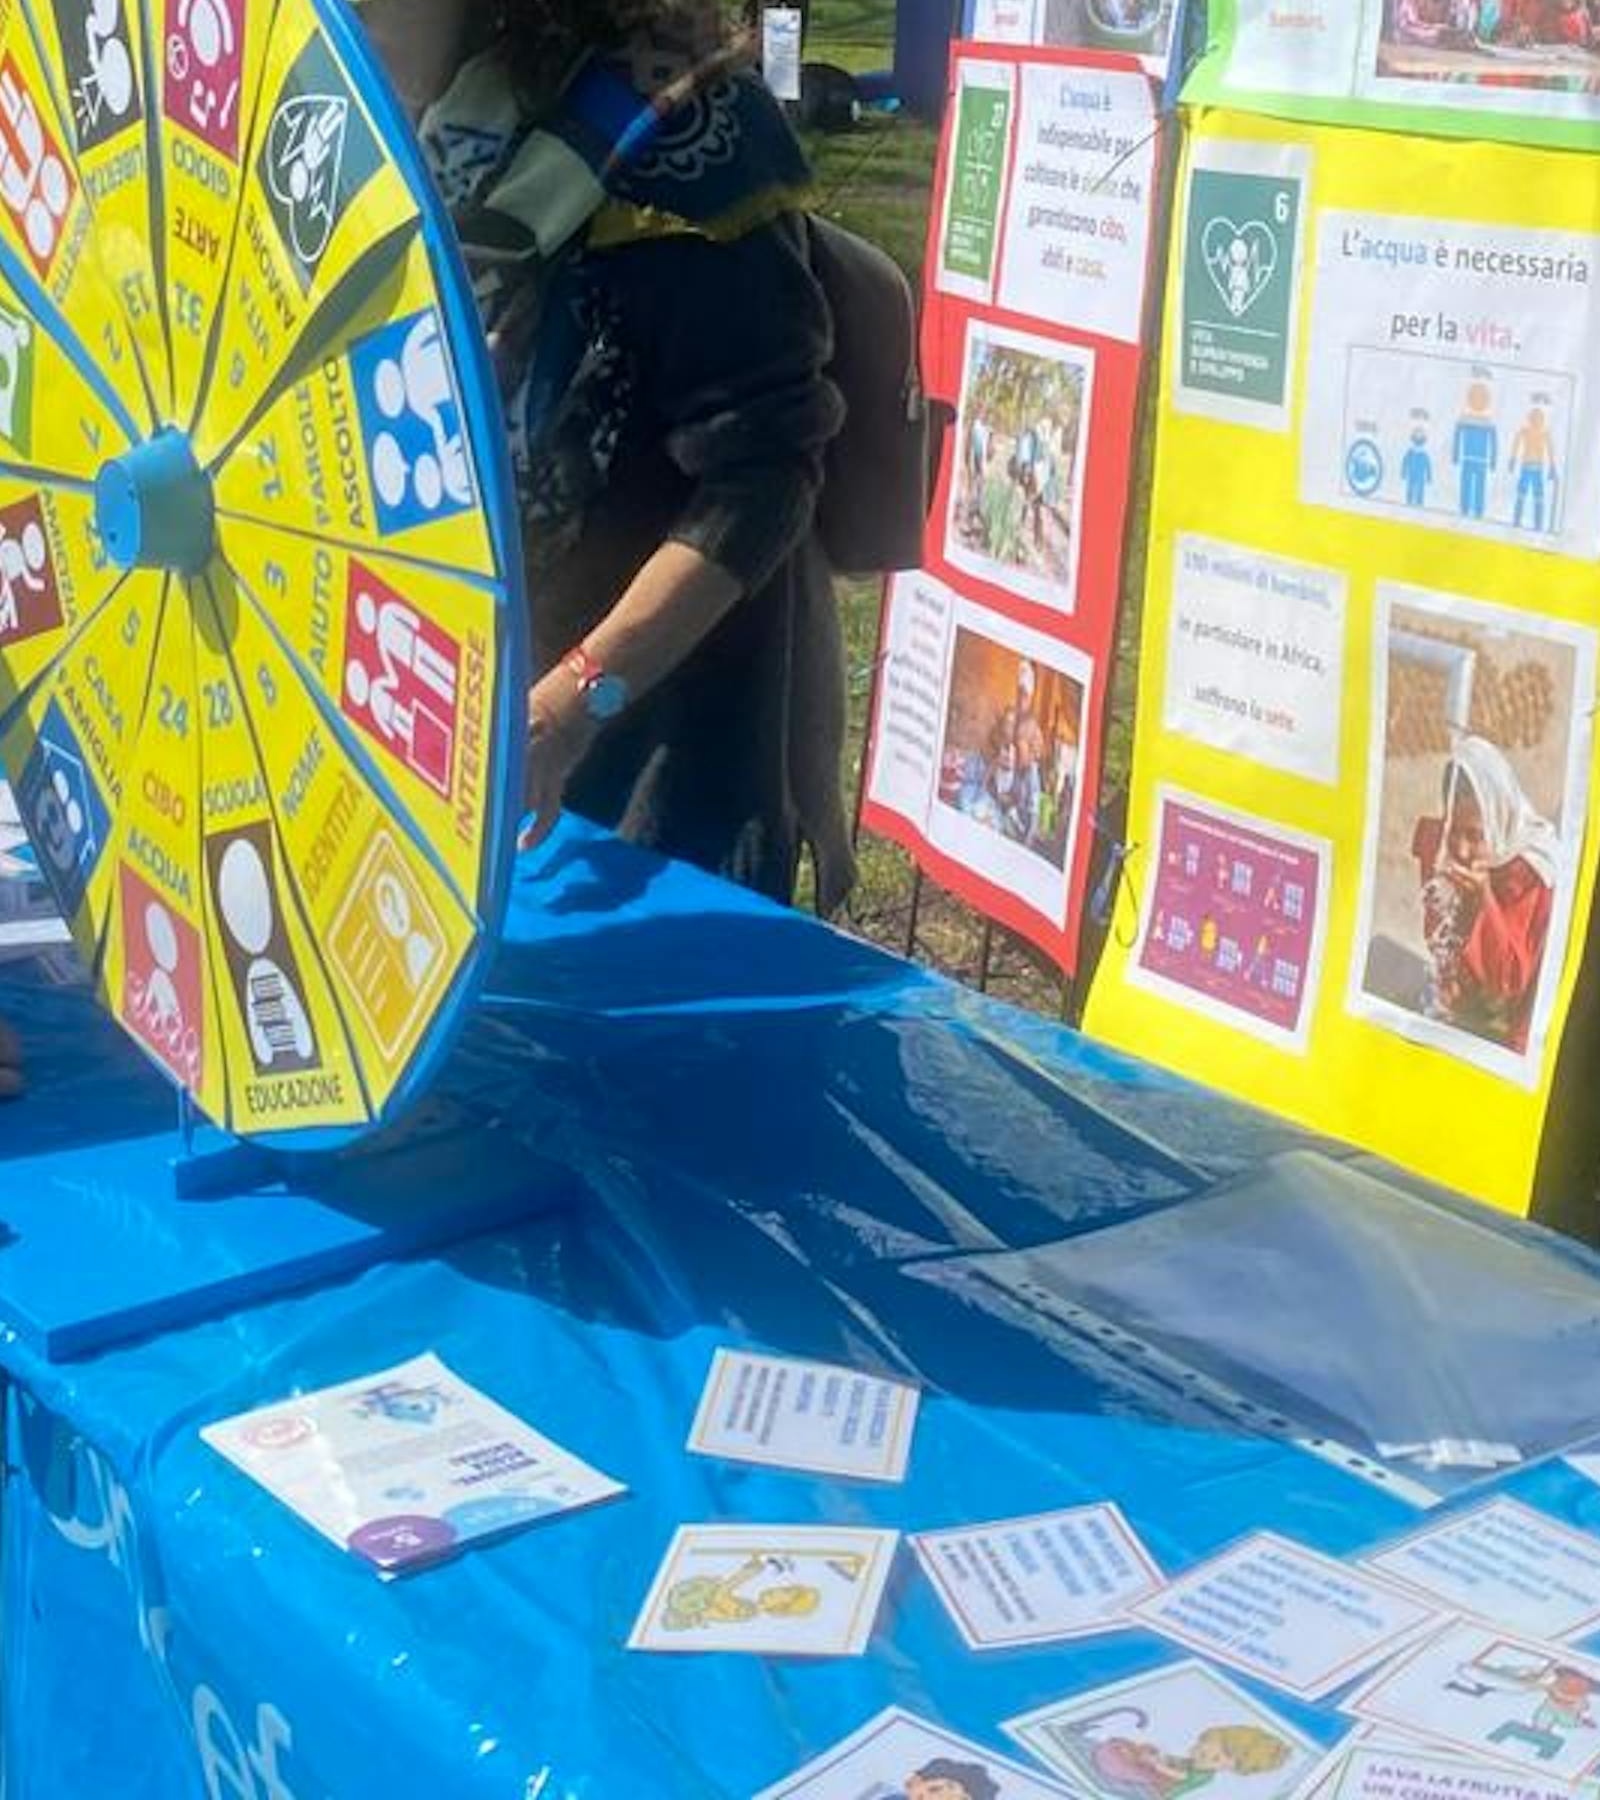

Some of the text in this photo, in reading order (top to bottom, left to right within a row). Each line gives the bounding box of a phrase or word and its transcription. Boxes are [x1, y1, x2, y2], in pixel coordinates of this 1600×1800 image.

[172, 138, 230, 201] GIOCO
[173, 206, 221, 263] ARTE
[1275, 192, 1290, 222] 6
[1342, 229, 1589, 284] L'acqua è necessaria
[175, 285, 202, 336] 31
[1390, 310, 1521, 351] per la vita.
[255, 436, 284, 499] 12
[293, 384, 331, 526] PAROLE
[323, 355, 366, 530] ASCOLTO
[264, 561, 288, 599] 3
[307, 549, 334, 674] AIUTO
[1193, 622, 1262, 654] particolare
[1281, 644, 1326, 677] Africa,
[158, 684, 188, 740] 24
[202, 682, 233, 729] 28
[257, 663, 277, 707] 8
[454, 628, 488, 846] INTERESSE
[143, 771, 186, 827] CIBO
[205, 771, 266, 817] SCUOLA
[280, 734, 327, 818] NOME
[127, 830, 192, 904] ACQUA
[245, 1075, 345, 1115] EDUCAZIONE
